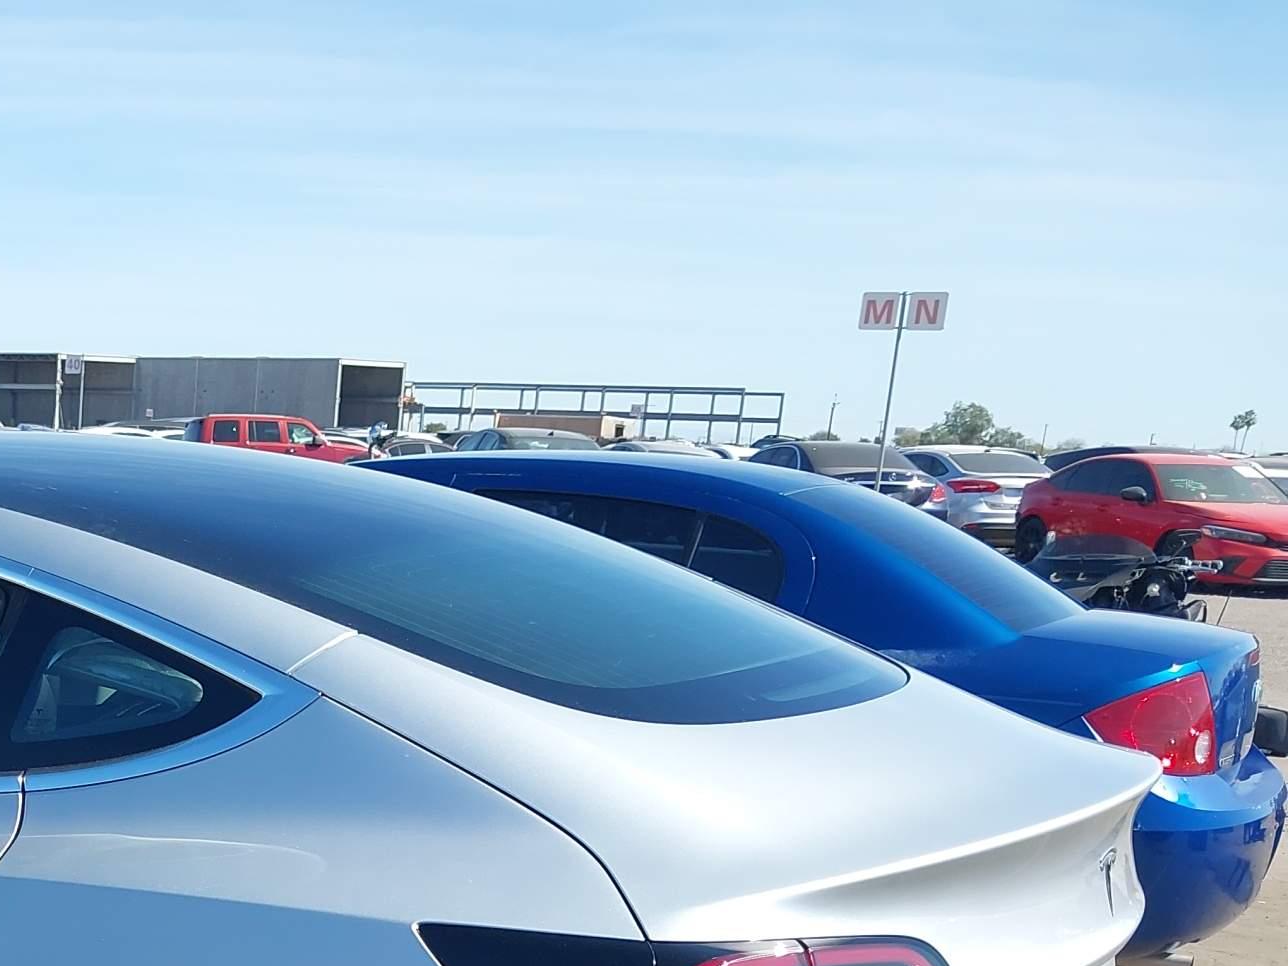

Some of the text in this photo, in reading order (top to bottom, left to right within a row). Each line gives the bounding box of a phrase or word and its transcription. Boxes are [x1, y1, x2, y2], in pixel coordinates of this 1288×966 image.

[863, 299, 940, 325] M N
[66, 358, 81, 370] 40
